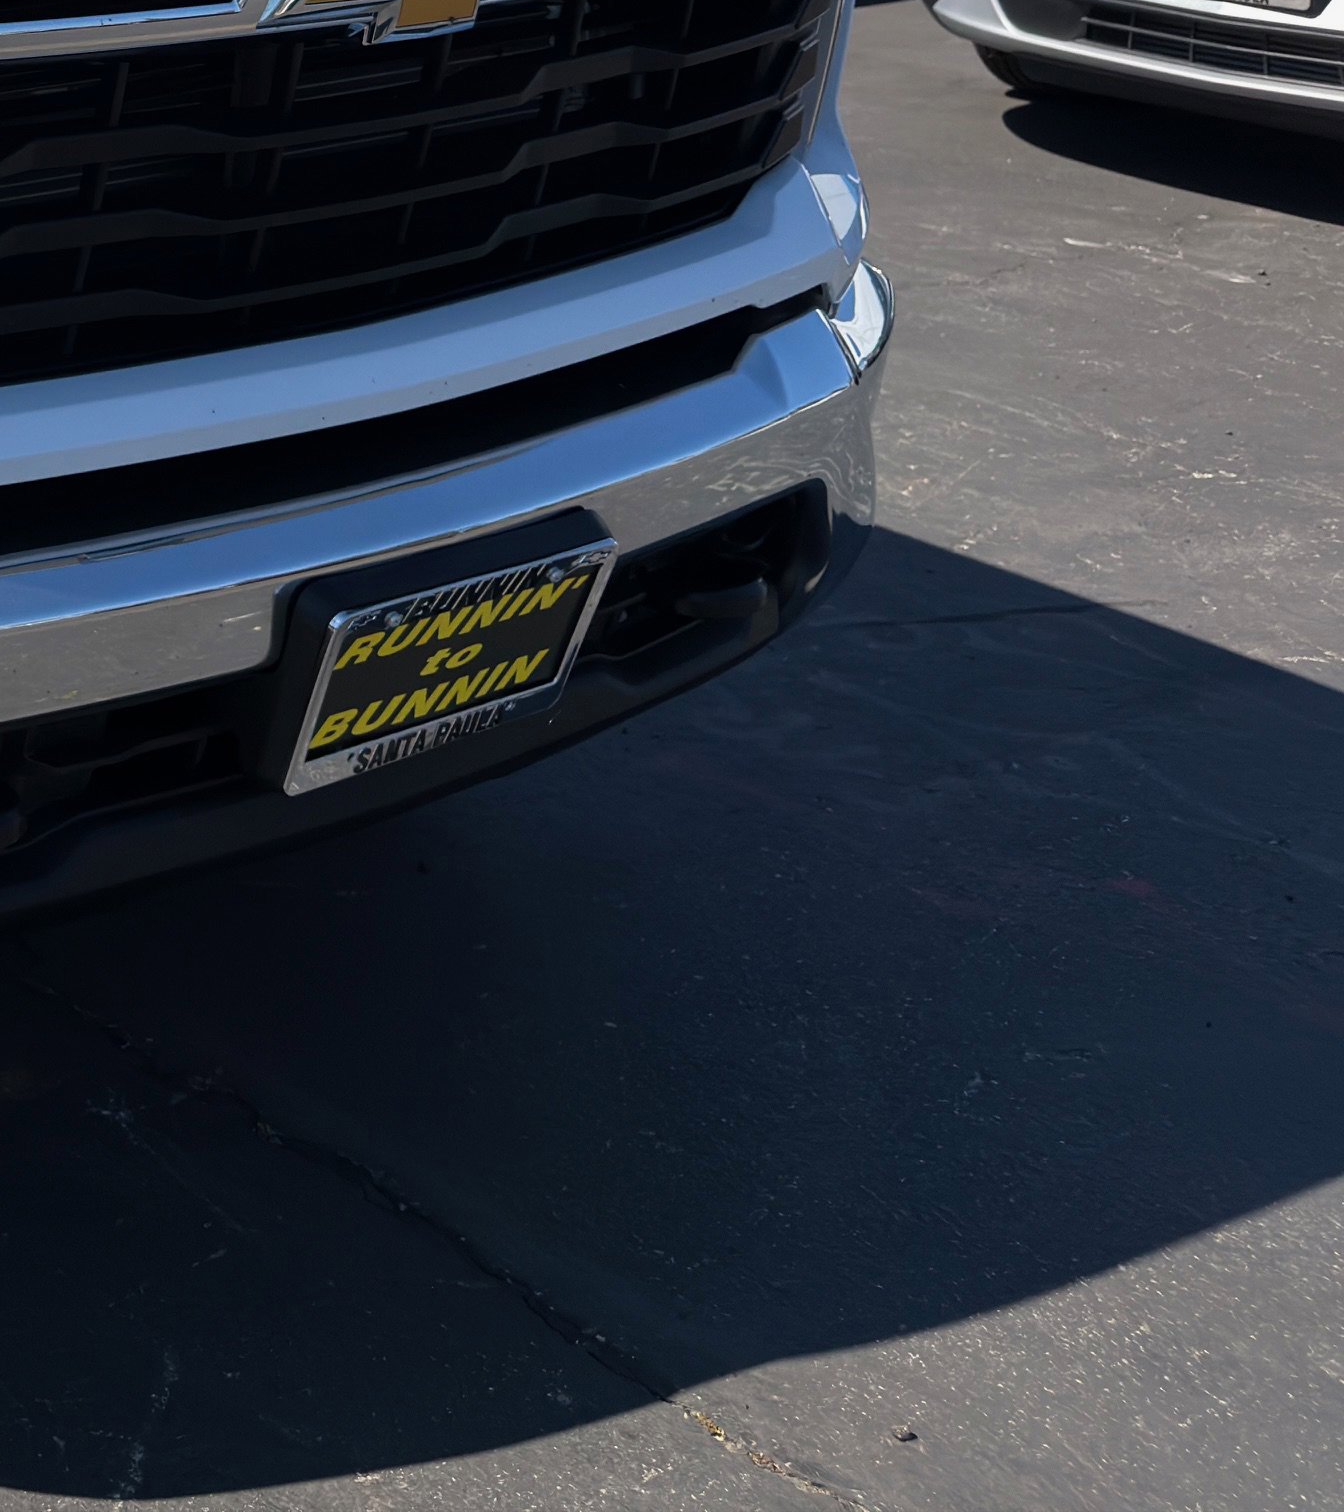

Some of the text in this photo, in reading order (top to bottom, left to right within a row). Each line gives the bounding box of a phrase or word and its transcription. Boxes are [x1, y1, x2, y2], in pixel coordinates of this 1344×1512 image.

[332, 574, 592, 671] RUNNIN'
[419, 643, 484, 677] to
[308, 648, 550, 751] BUNNIN
